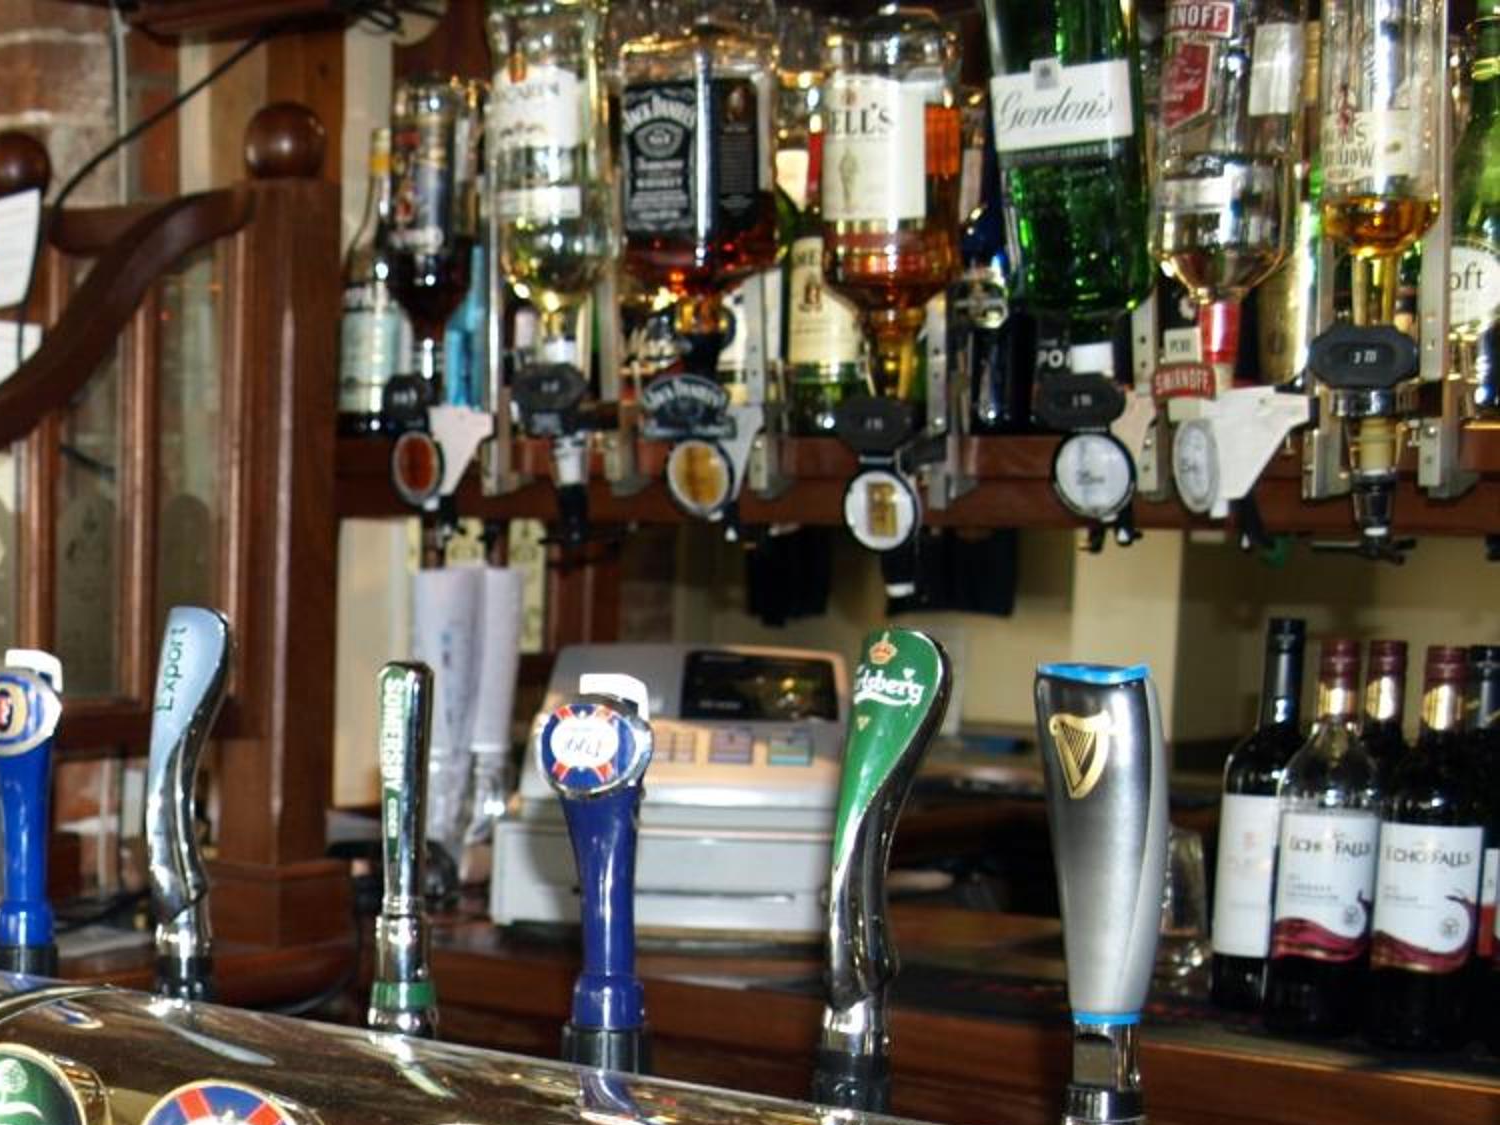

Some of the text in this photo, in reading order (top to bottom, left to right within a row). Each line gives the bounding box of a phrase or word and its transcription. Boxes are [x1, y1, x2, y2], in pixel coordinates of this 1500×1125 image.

[998, 86, 1114, 130] Gordon's
[1449, 261, 1484, 291] oft
[154, 626, 188, 711] Export
